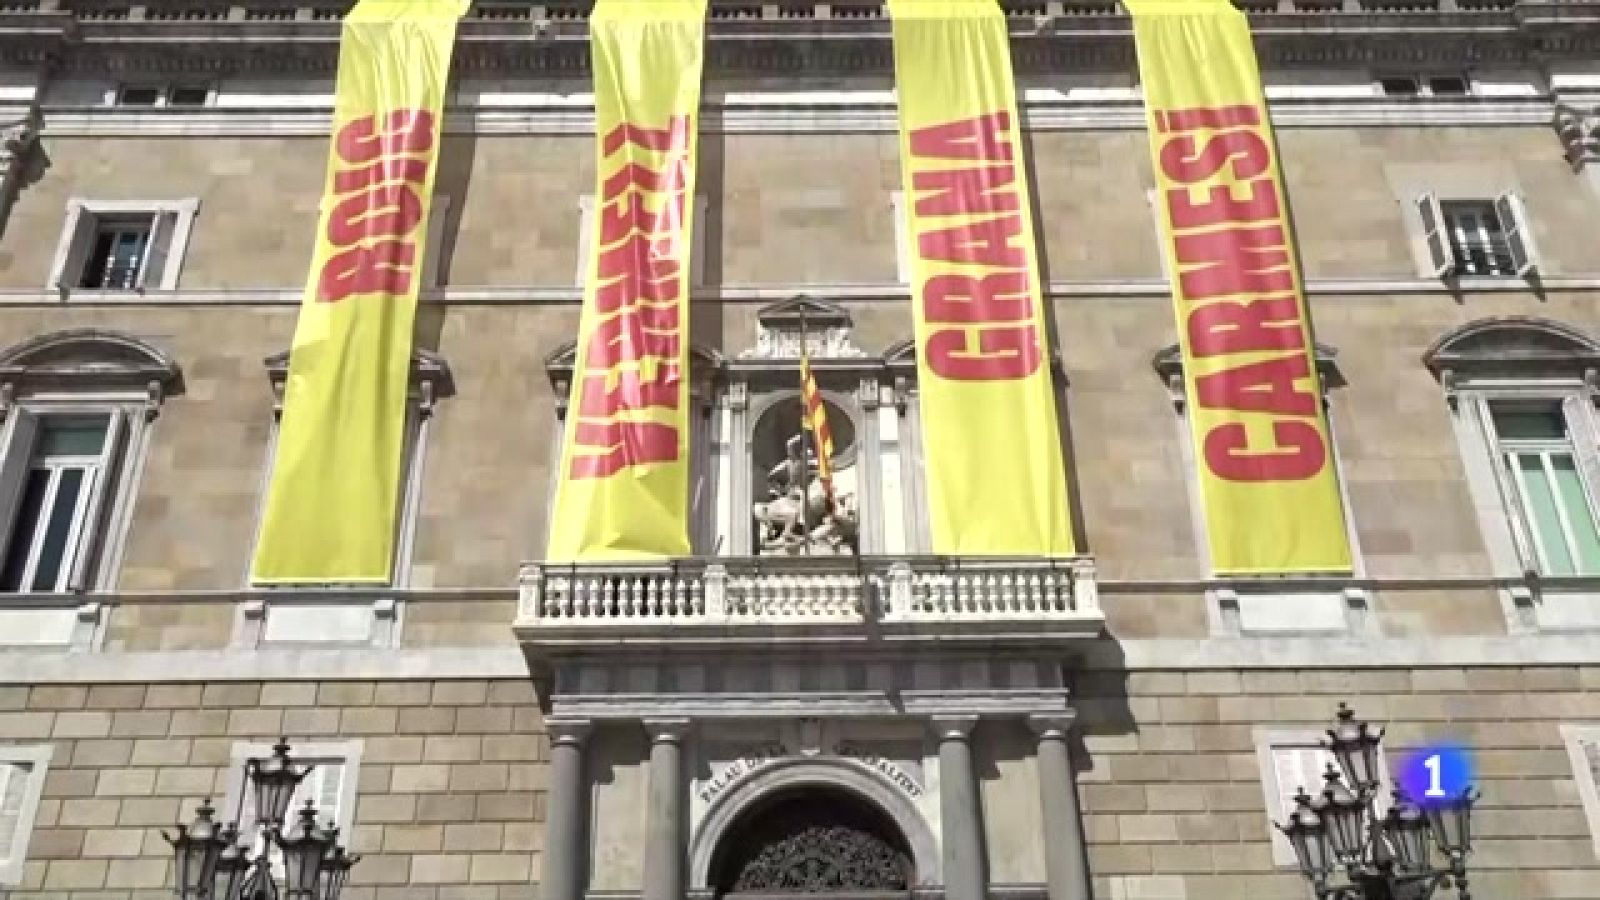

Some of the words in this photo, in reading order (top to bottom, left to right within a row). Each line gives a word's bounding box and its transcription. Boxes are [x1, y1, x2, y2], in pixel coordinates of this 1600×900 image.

[315, 108, 435, 303] ROIG
[570, 115, 691, 479] VERMELL
[908, 111, 1042, 381] GRANA
[1154, 105, 1327, 482] CARMESÍ
